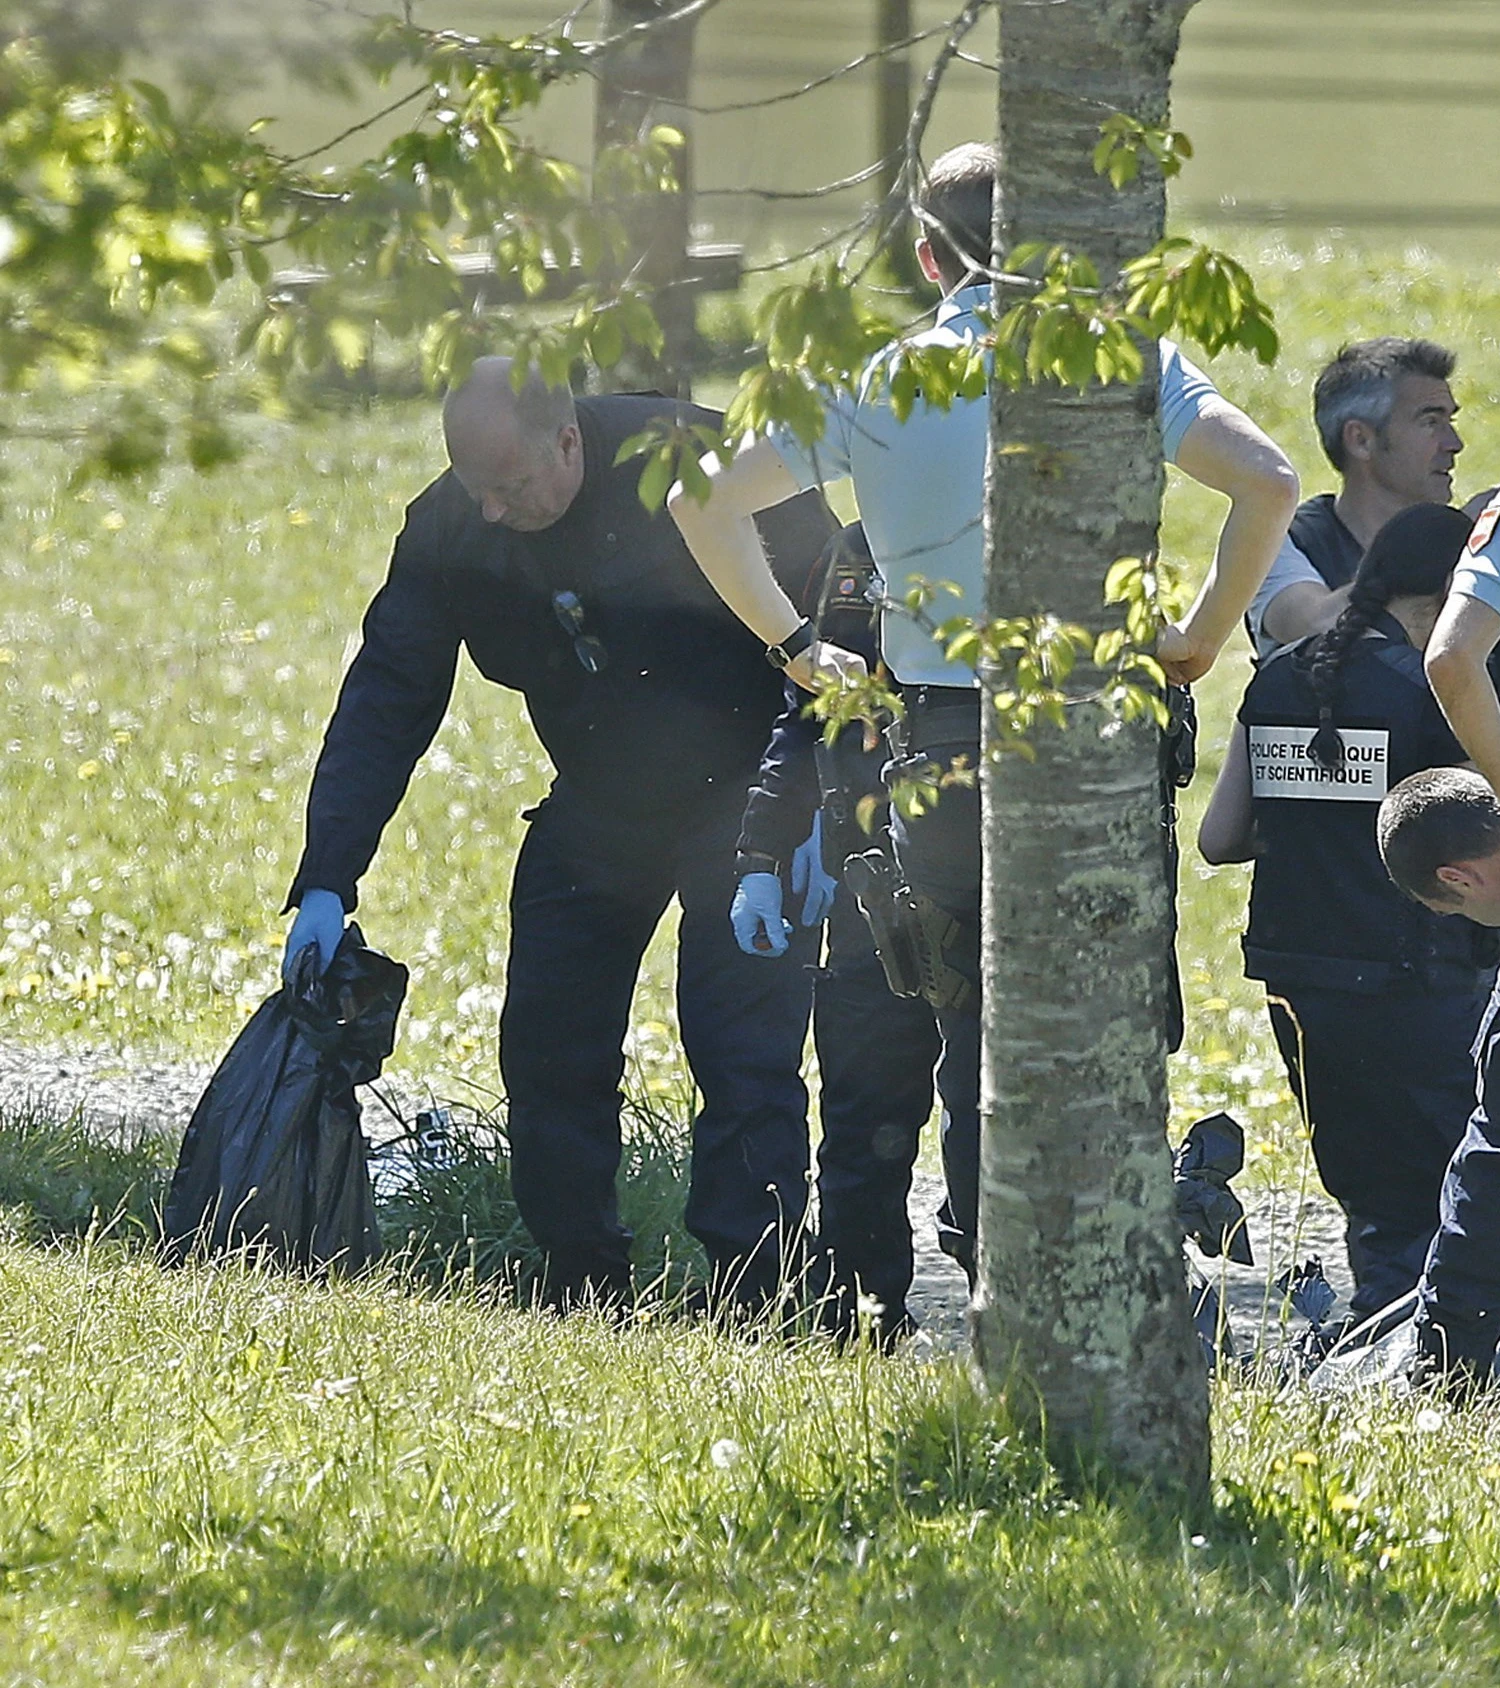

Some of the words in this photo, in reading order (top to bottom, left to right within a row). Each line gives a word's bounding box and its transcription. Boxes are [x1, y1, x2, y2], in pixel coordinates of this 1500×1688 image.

[1251, 743, 1287, 759] POLICE
[1256, 766, 1266, 780] ET
[1268, 766, 1373, 784] SCIENTIFIQUE
